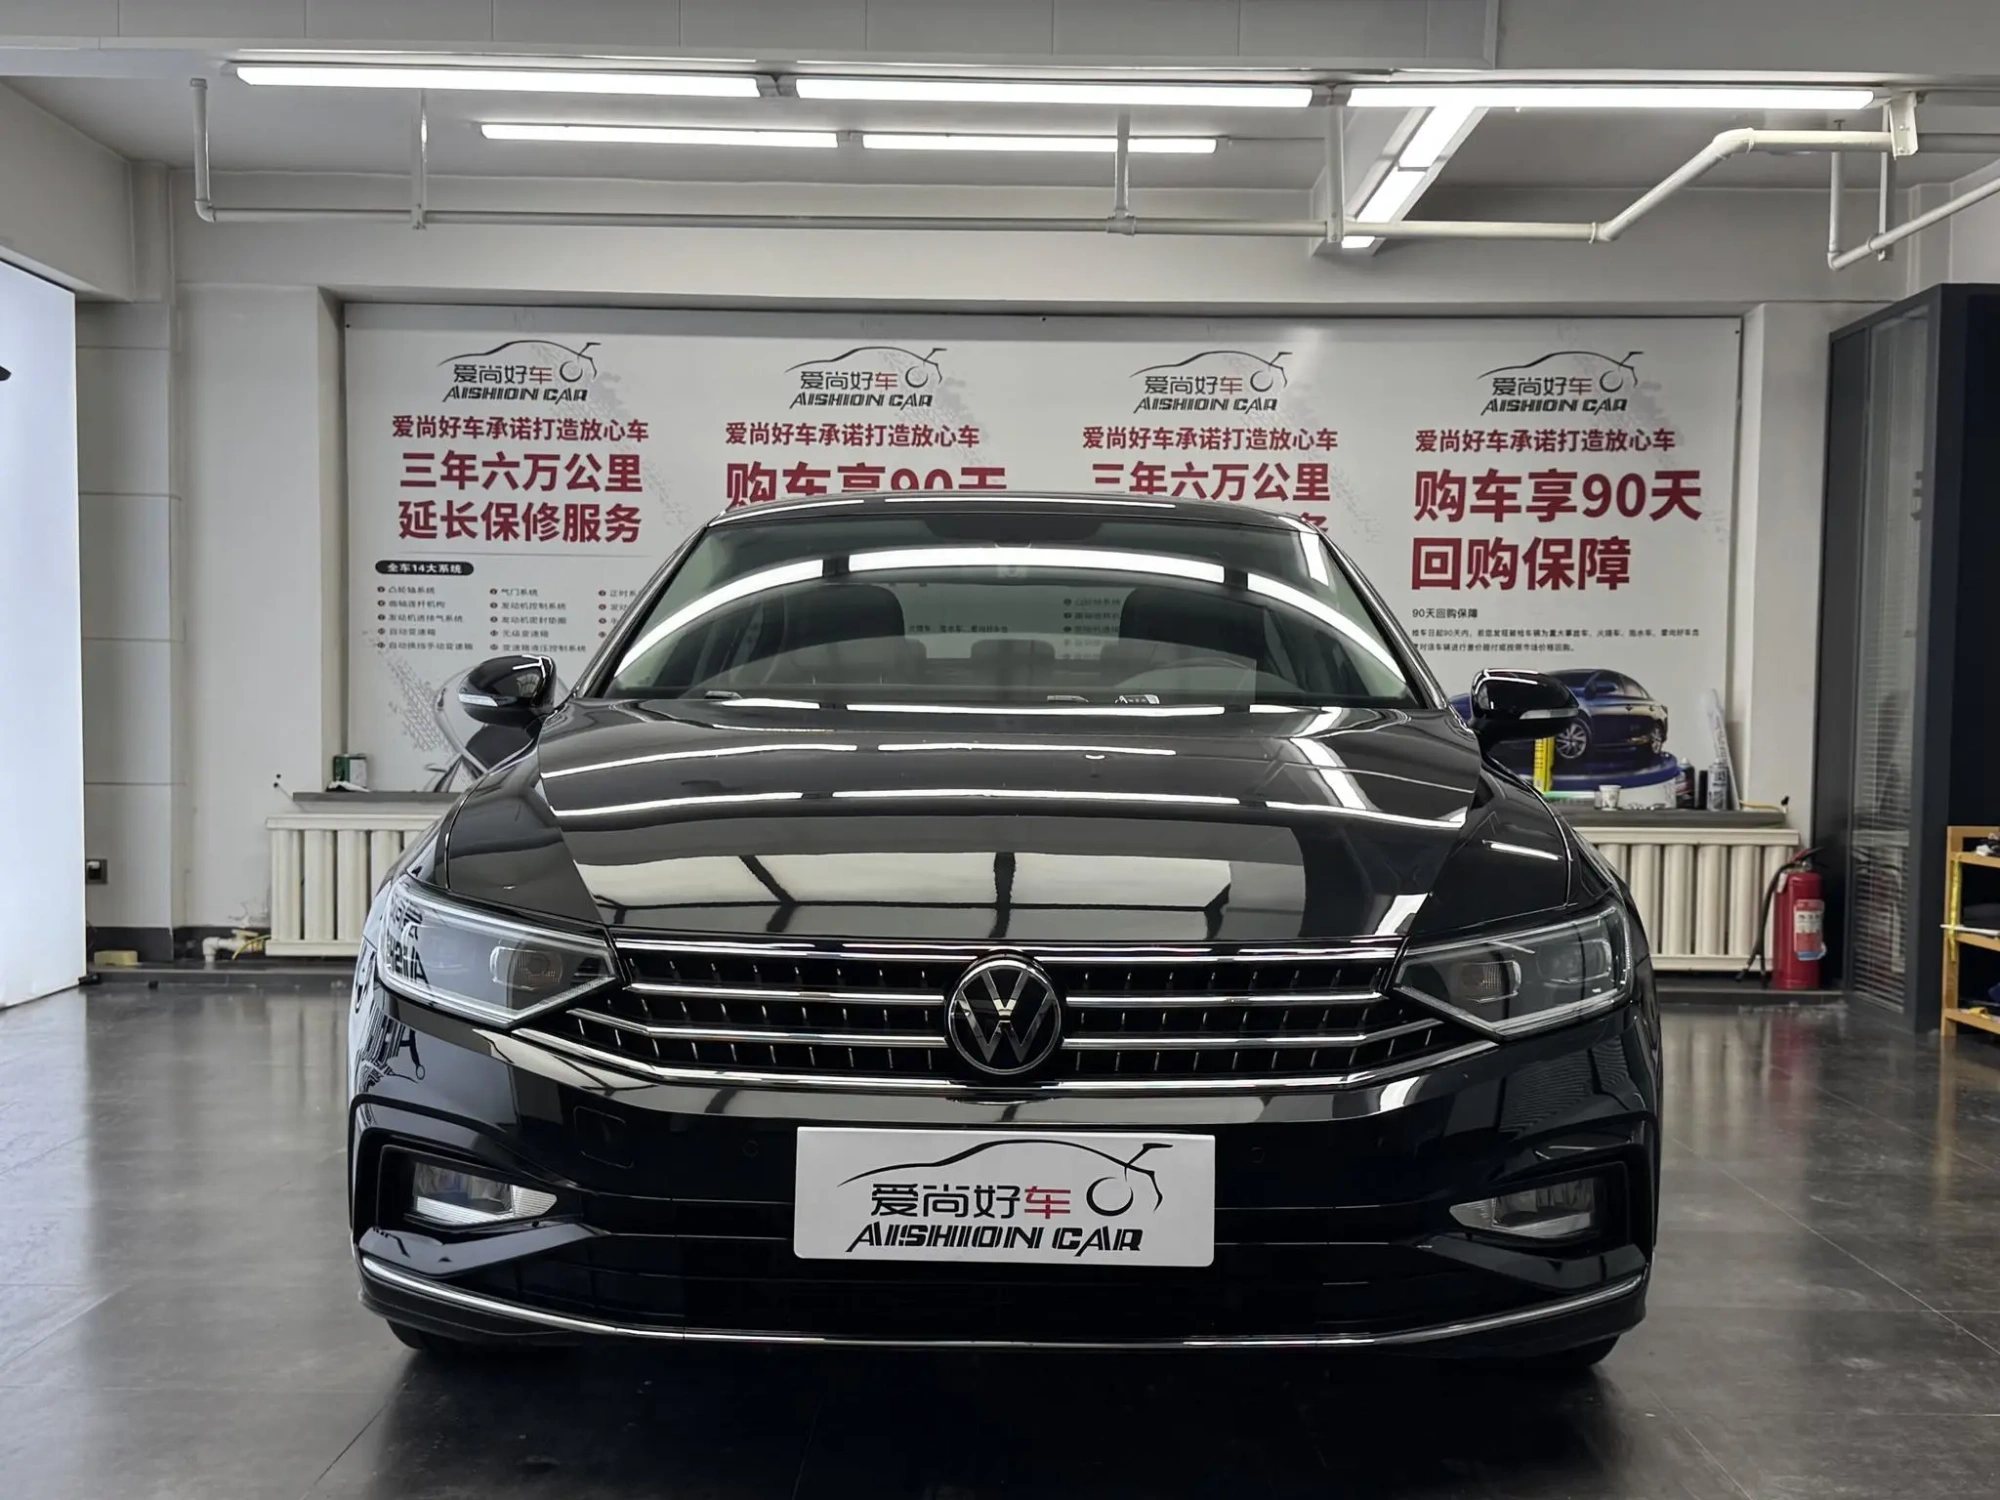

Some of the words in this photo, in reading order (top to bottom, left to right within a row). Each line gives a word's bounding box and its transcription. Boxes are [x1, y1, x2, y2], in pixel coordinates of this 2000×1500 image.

[453, 364, 553, 385] 爱尚好车
[800, 371, 898, 391] 爱尚好车
[1145, 375, 1243, 395] 爱尚好车
[442, 386, 539, 403] AISHION
[544, 387, 588, 405] CAR
[1492, 377, 1593, 397] 爱尚好车
[789, 392, 885, 410] AISHION
[888, 393, 934, 411] CAR
[1133, 396, 1229, 414] AISHION
[1233, 397, 1278, 415] CAR
[1481, 398, 1578, 416] AISHION
[1582, 399, 1628, 416] CAR
[392, 415, 649, 442] 爱尚好车承诺打造放心车
[725, 422, 980, 448] 爱尚好车承诺打造放心车
[1082, 426, 1338, 452] 爱尚好车承诺打造放心车
[1415, 428, 1675, 453] 爱尚好车承诺打造放心车
[400, 450, 643, 493] 三年六万公里
[1413, 468, 1702, 523] 购车享90天
[398, 500, 642, 543] 延长保修服务
[387, 562, 462, 574] 全车14大系统
[1411, 535, 1631, 591] 回购保障
[1412, 608, 1478, 619] 90天回购保障
[870, 1183, 1071, 1220] 爱尚好车
[1051, 1225, 1144, 1257] CAR
